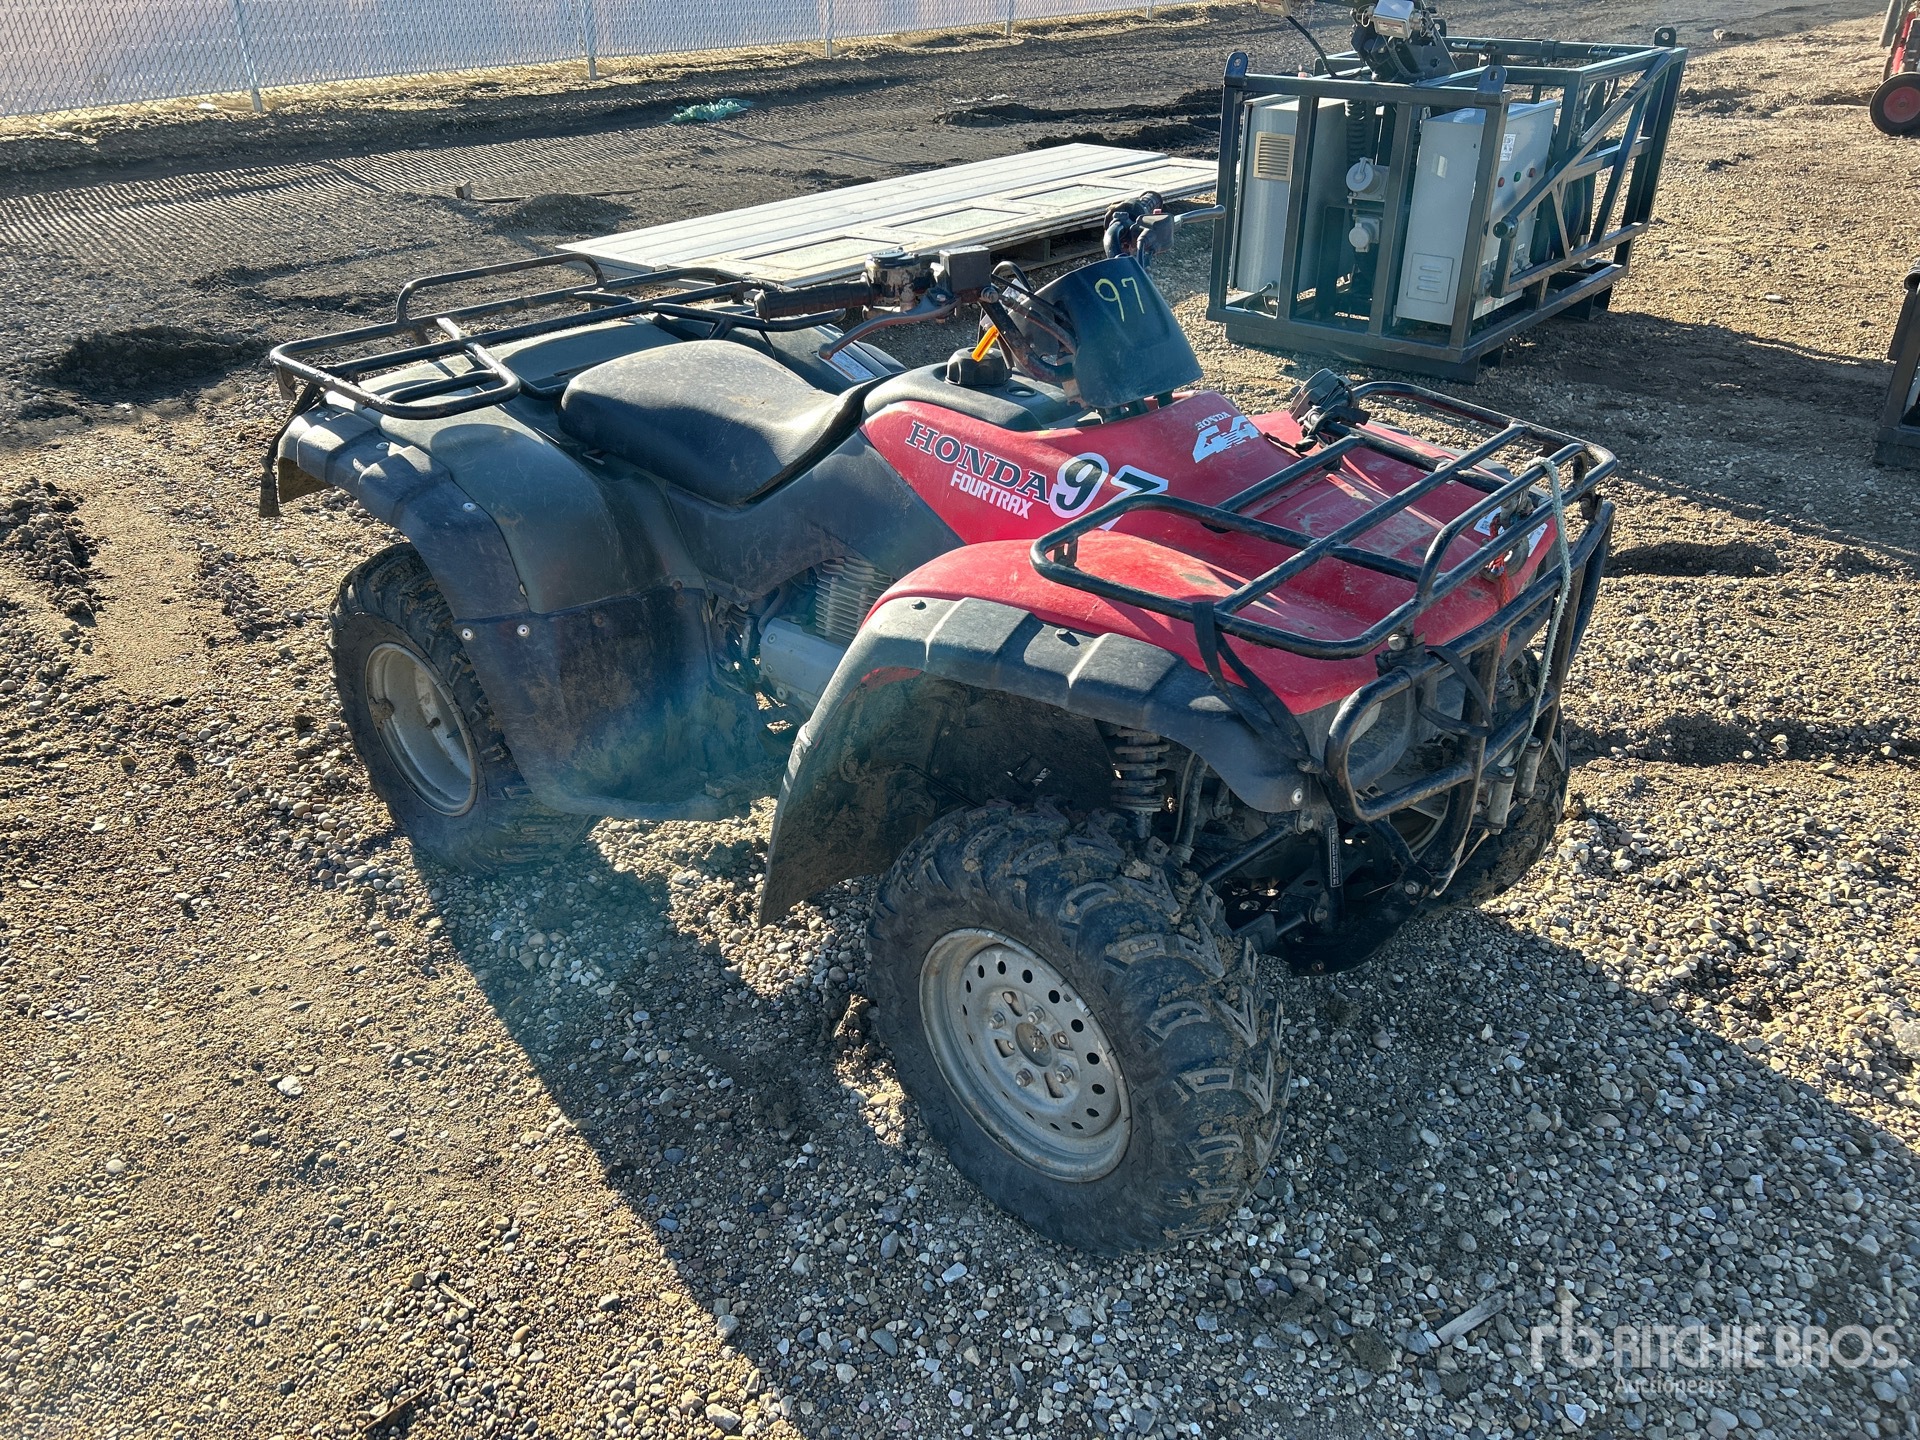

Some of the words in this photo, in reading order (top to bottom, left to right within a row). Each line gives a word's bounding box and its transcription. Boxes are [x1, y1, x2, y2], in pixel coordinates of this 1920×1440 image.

[1094, 276, 1145, 322] 97
[1195, 411, 1231, 431] HONDA
[904, 420, 1050, 504] HONDA
[950, 470, 1033, 520] FOURTRAX
[1050, 452, 1169, 532] 97
